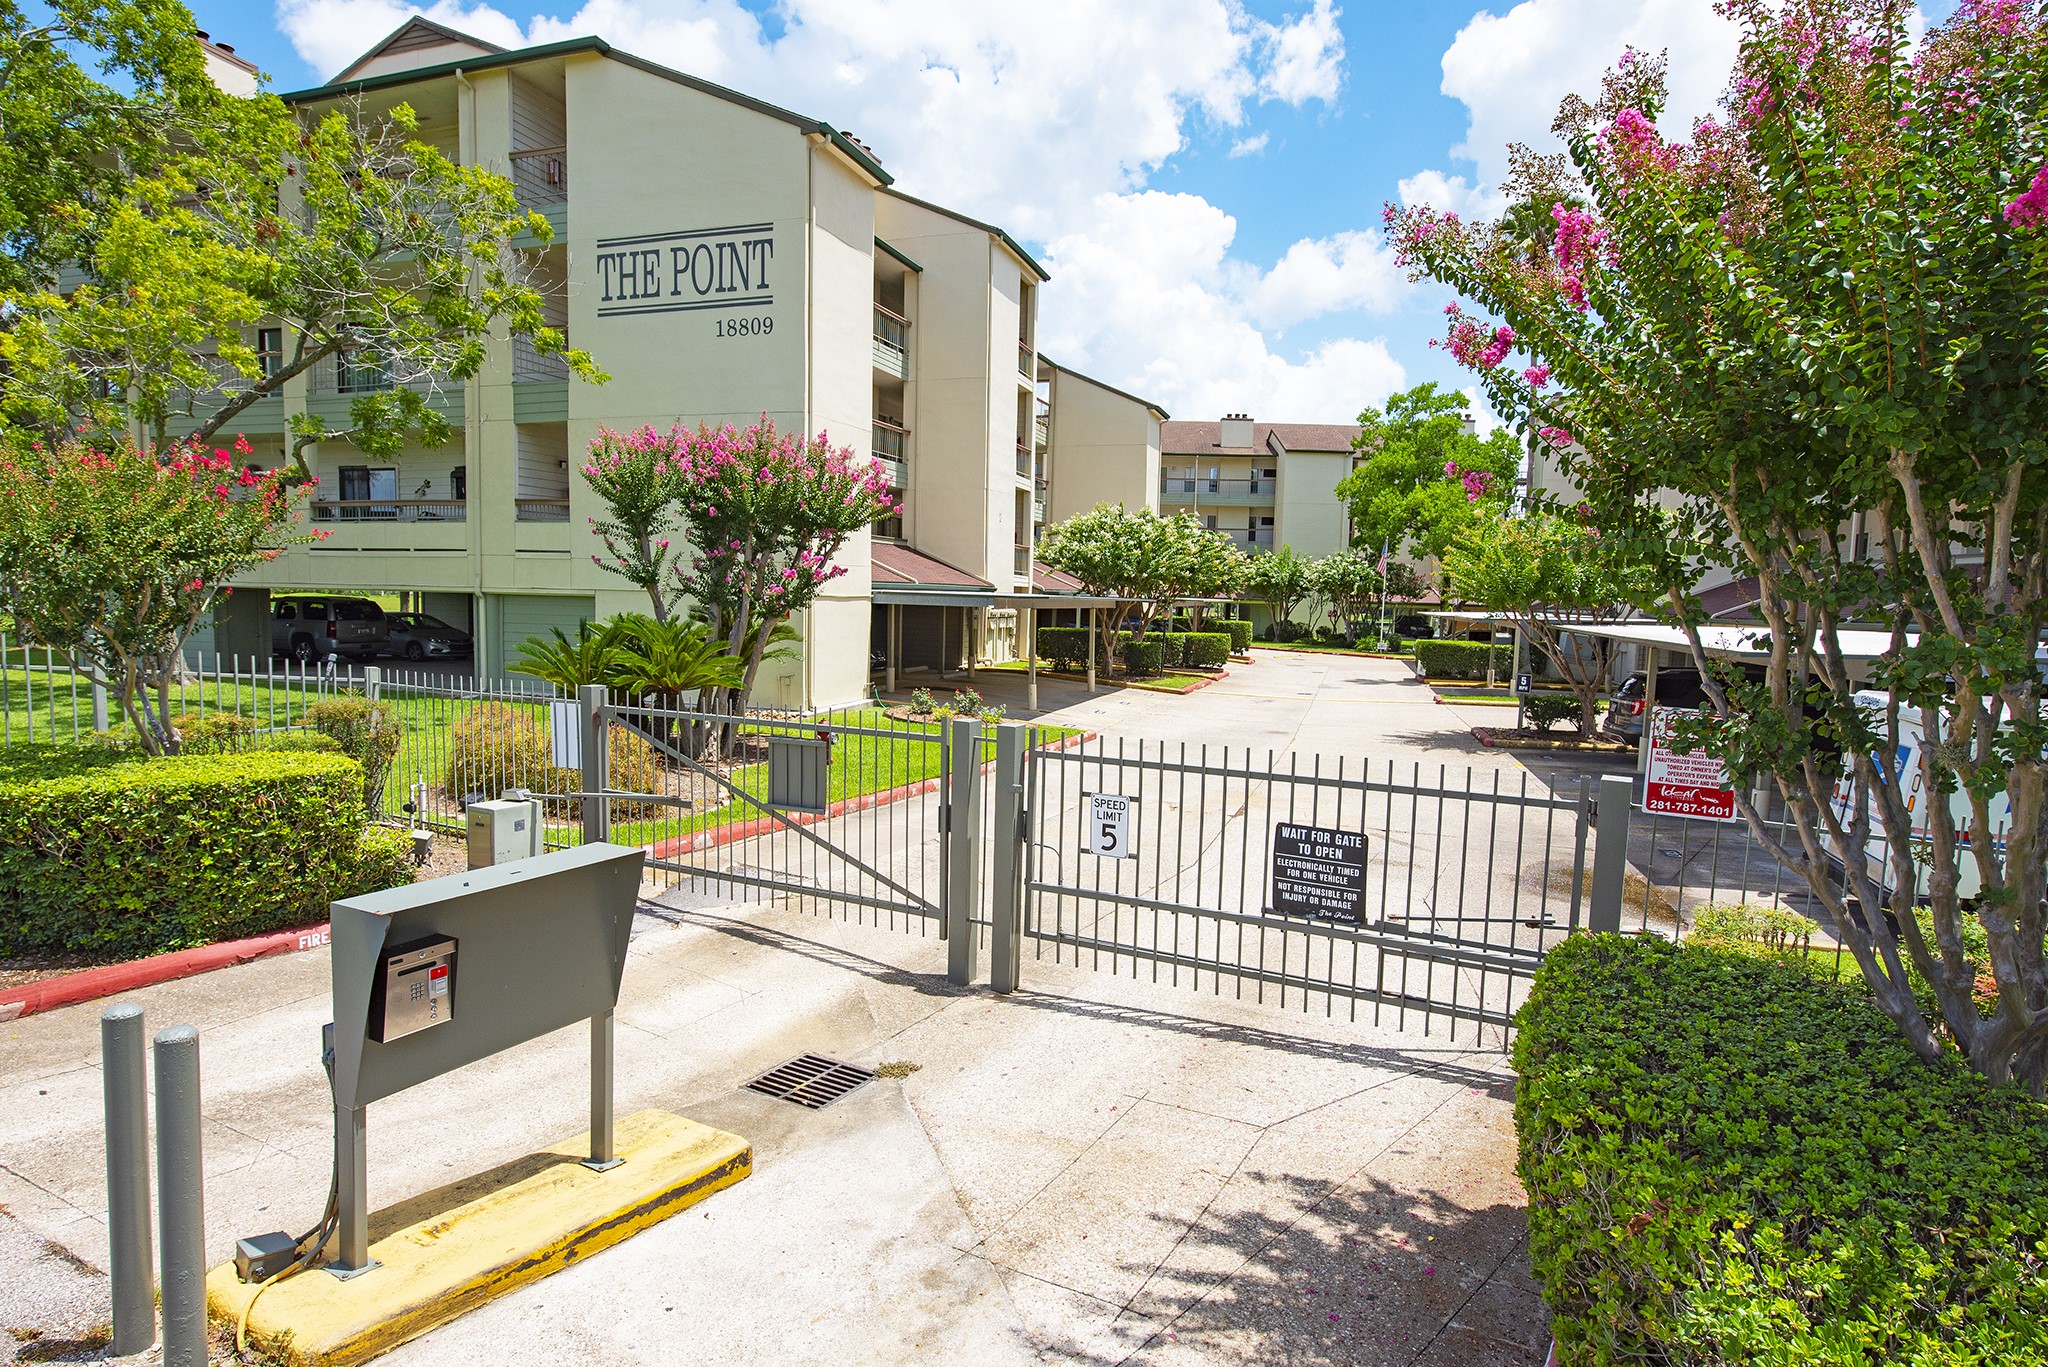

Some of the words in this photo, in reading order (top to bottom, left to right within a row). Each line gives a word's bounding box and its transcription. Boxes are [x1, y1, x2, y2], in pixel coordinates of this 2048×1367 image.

[597, 249, 660, 302] THE
[670, 238, 774, 296] POINT
[716, 316, 774, 338] 18809
[1521, 677, 1526, 685] 5
[1654, 757, 1691, 765] UNAUTHORIZED
[1666, 771, 1696, 779] OPERATOR'S
[1696, 773, 1718, 781] EXPENSE
[1690, 766, 1712, 774] OWNER'S
[1094, 798, 1126, 811] SPEED
[1650, 800, 1730, 816] 281-787-1401
[1096, 810, 1122, 822] LIMIT
[1101, 823, 1117, 851] 5
[1281, 826, 1307, 840] WAIT
[1311, 830, 1331, 844] FOR
[1335, 834, 1362, 848] GATE
[1298, 843, 1311, 855] TO
[1316, 845, 1343, 860] OPEN
[1277, 858, 1335, 874] ELECTRONICALLY
[1337, 867, 1360, 877] TIMED
[1287, 868, 1300, 878] FOR
[1303, 871, 1317, 880] ONE
[1320, 874, 1348, 885] VEHICLE
[1278, 881, 1291, 891] NOT
[1293, 884, 1341, 899] RESPONSIBLE
[1343, 892, 1358, 901] FOR
[1282, 891, 1306, 903] INJURY
[1309, 895, 1319, 905] OR
[1322, 898, 1352, 910] DAMAGE
[1318, 909, 1332, 917] The
[1333, 911, 1355, 920] Point
[299, 931, 331, 950] FIRE
